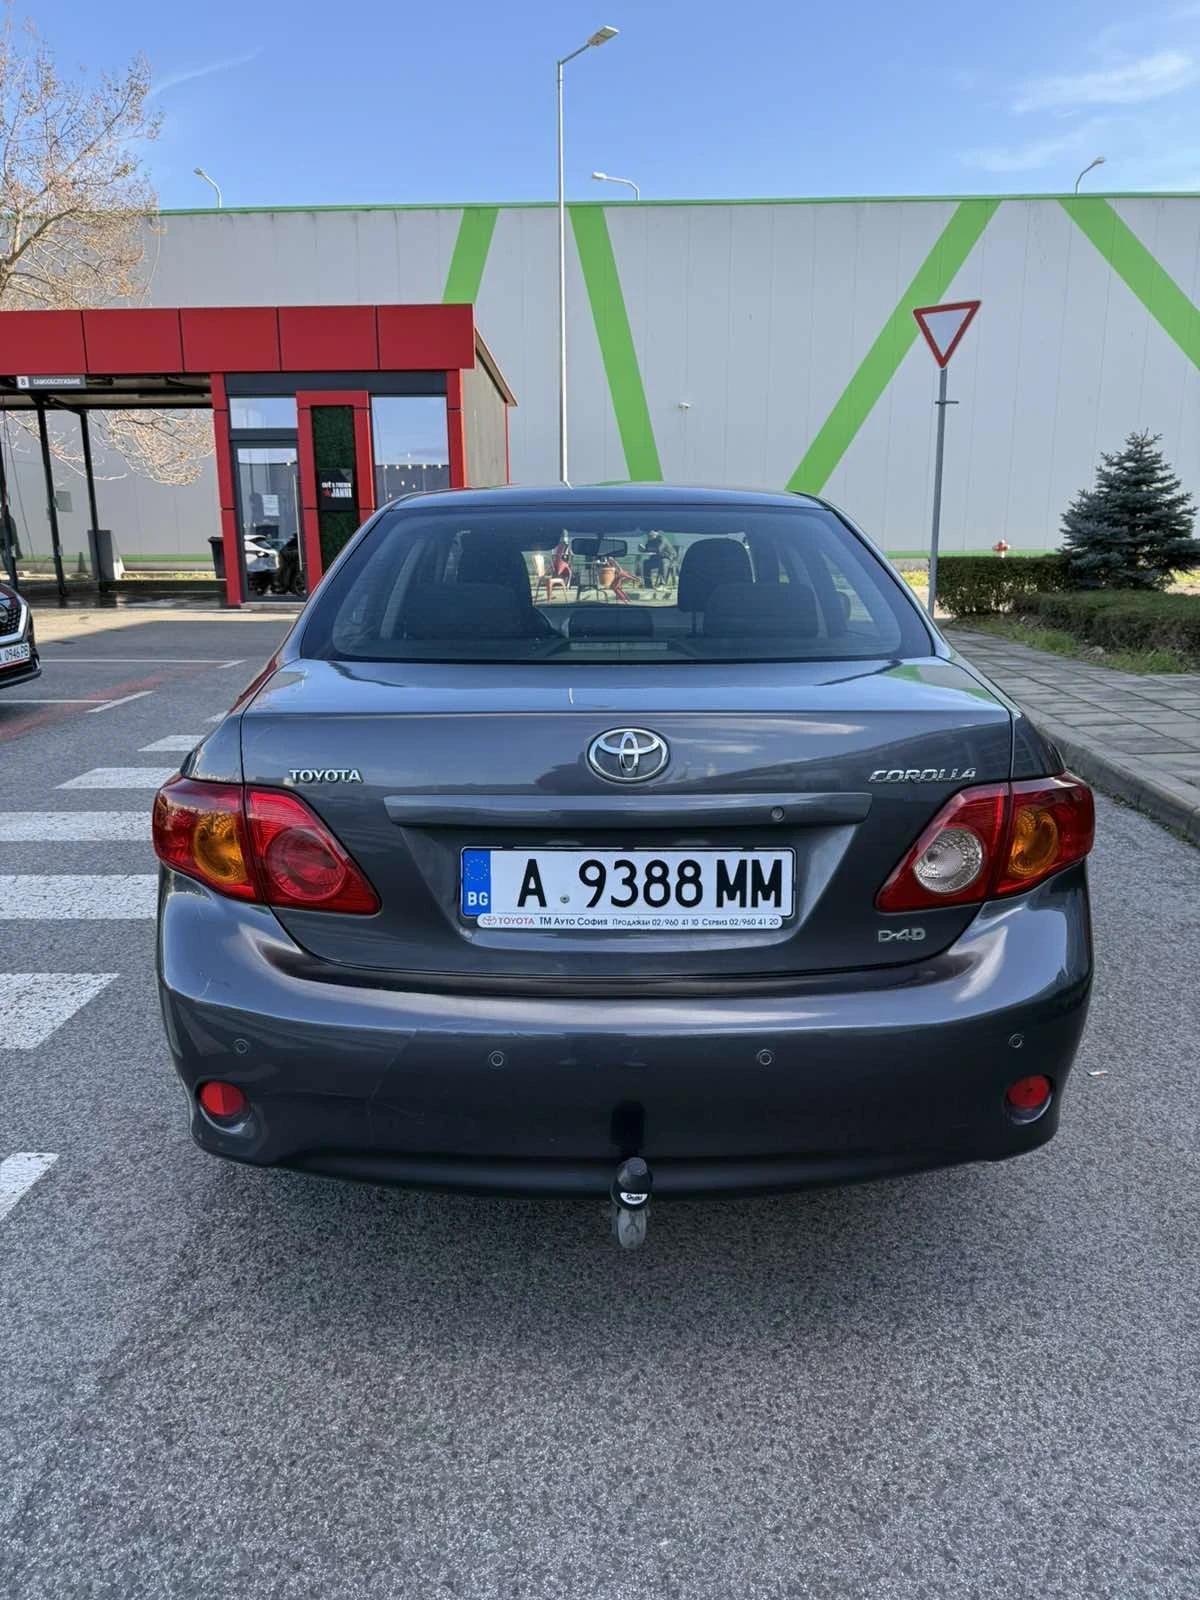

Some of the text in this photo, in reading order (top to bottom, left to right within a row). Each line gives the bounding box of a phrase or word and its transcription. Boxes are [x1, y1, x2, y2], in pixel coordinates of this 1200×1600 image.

[288, 768, 363, 783] TOYOTA
[867, 768, 977, 783] COROLLA
[516, 858, 783, 909] A 9388 MM
[467, 891, 489, 907] BG
[498, 916, 535, 926] TOYOTA
